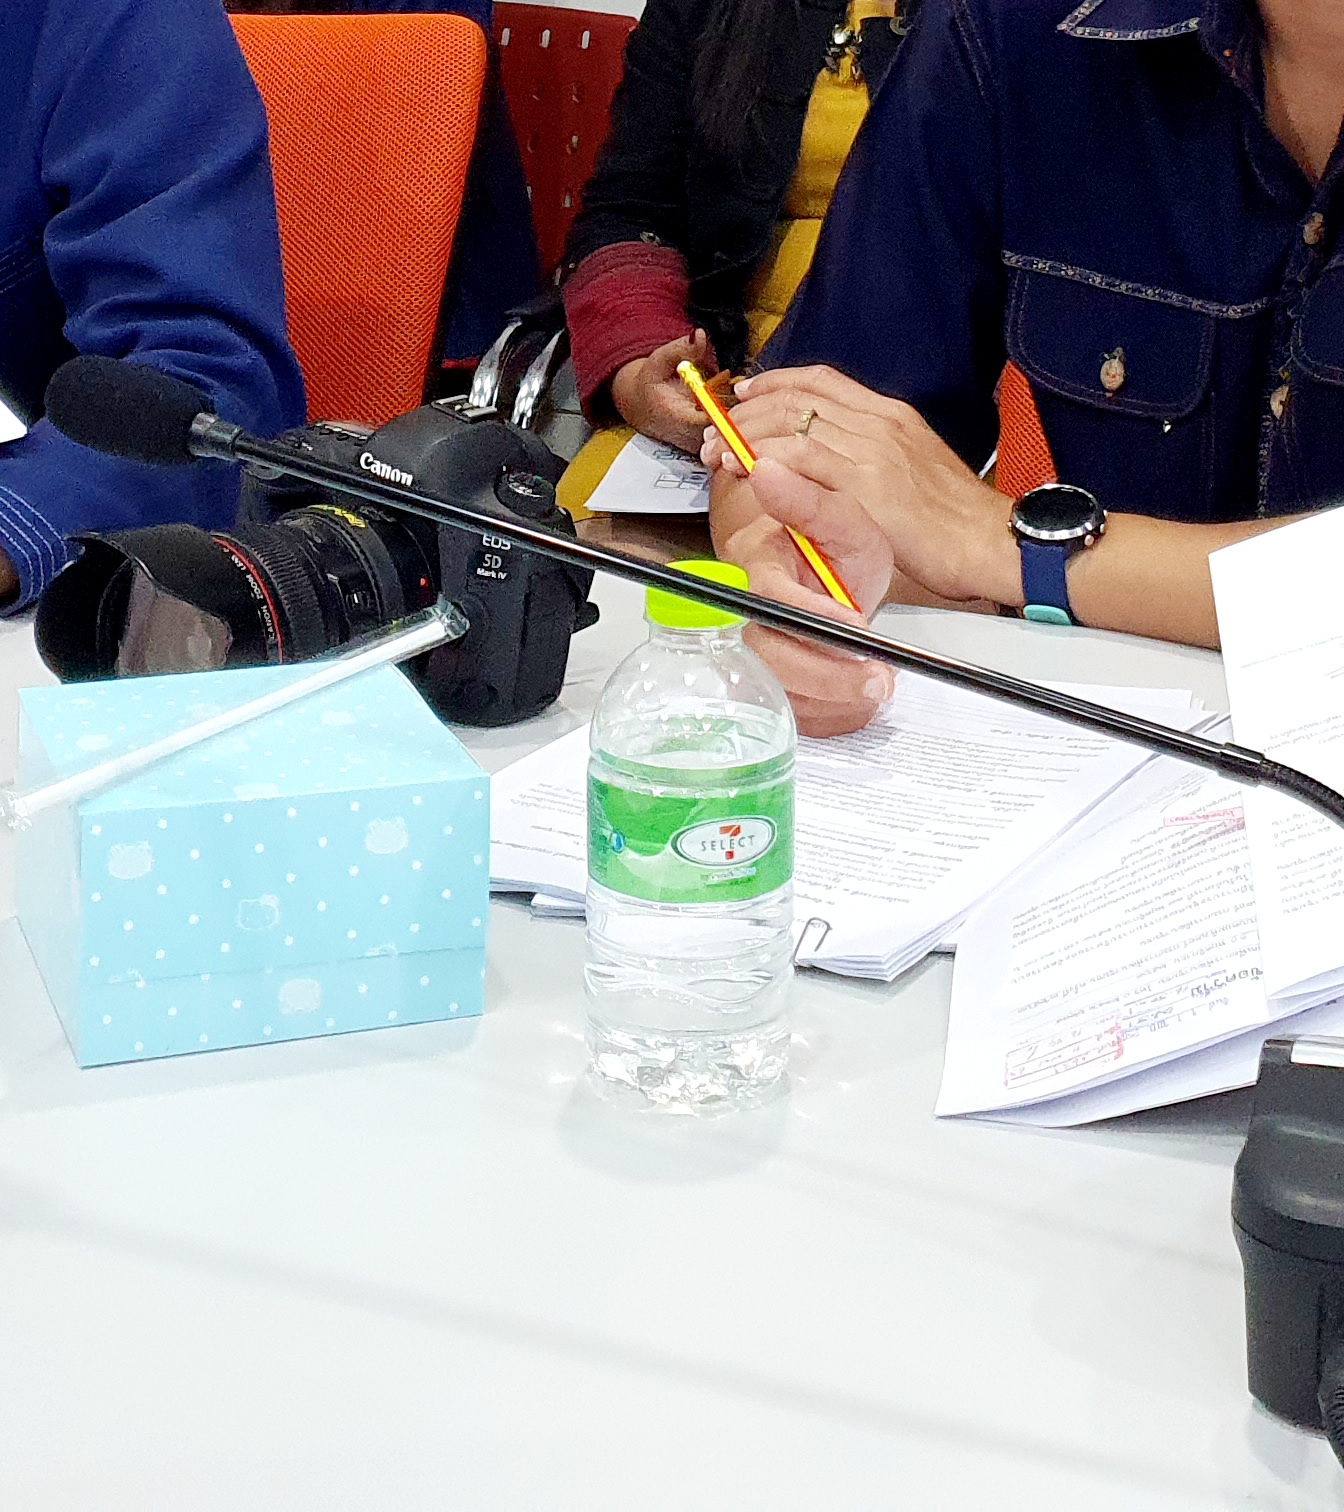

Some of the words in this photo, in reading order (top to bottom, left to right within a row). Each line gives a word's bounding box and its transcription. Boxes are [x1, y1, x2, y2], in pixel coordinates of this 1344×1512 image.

[359, 451, 414, 487] Canon
[481, 533, 512, 551] EOS
[482, 554, 502, 569] 5D
[476, 567, 498, 579] Mark
[700, 834, 756, 852] SELECT
